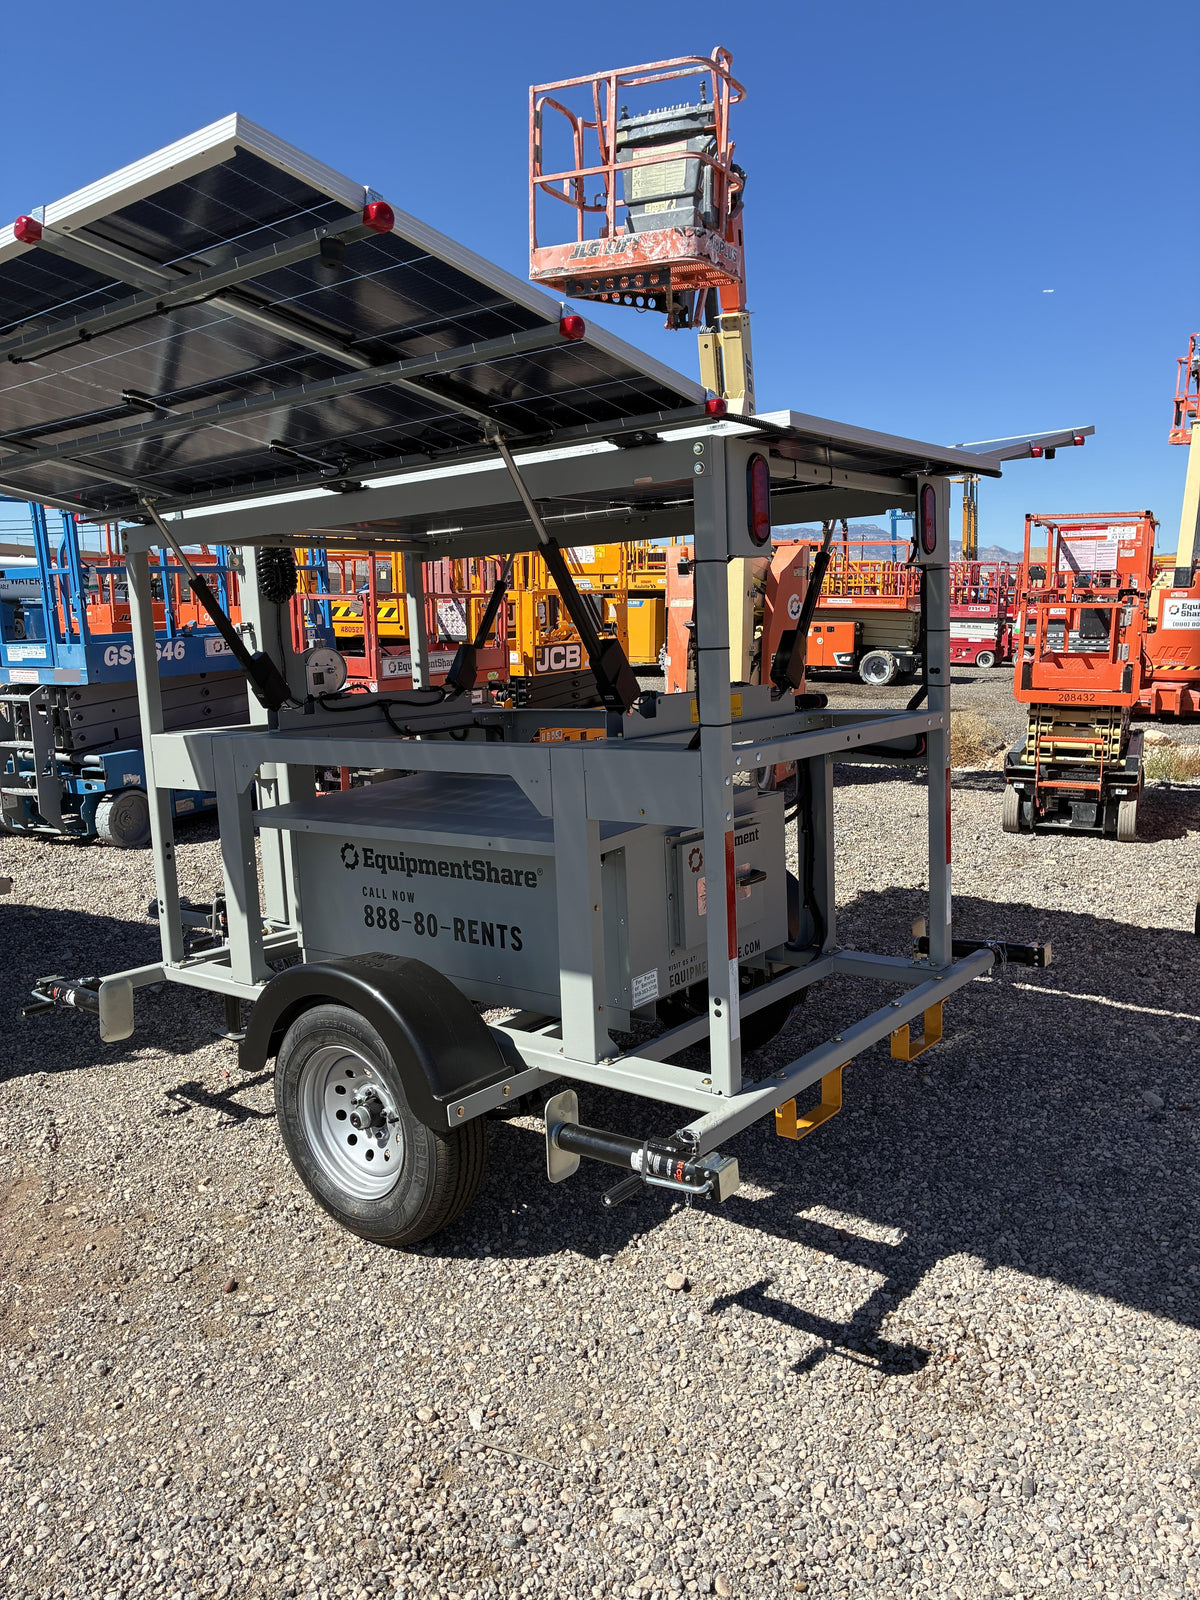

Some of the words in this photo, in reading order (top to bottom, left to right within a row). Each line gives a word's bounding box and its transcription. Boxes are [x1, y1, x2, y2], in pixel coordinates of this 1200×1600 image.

[569, 241, 600, 259] JLG
[536, 644, 581, 672] JCB
[1058, 693, 1096, 702] 208432
[362, 886, 387, 900] CALL
[392, 890, 415, 904] NOW
[364, 904, 523, 952] 888-80-RENTS
[668, 961, 681, 972] VISIT
[682, 958, 689, 968] US
